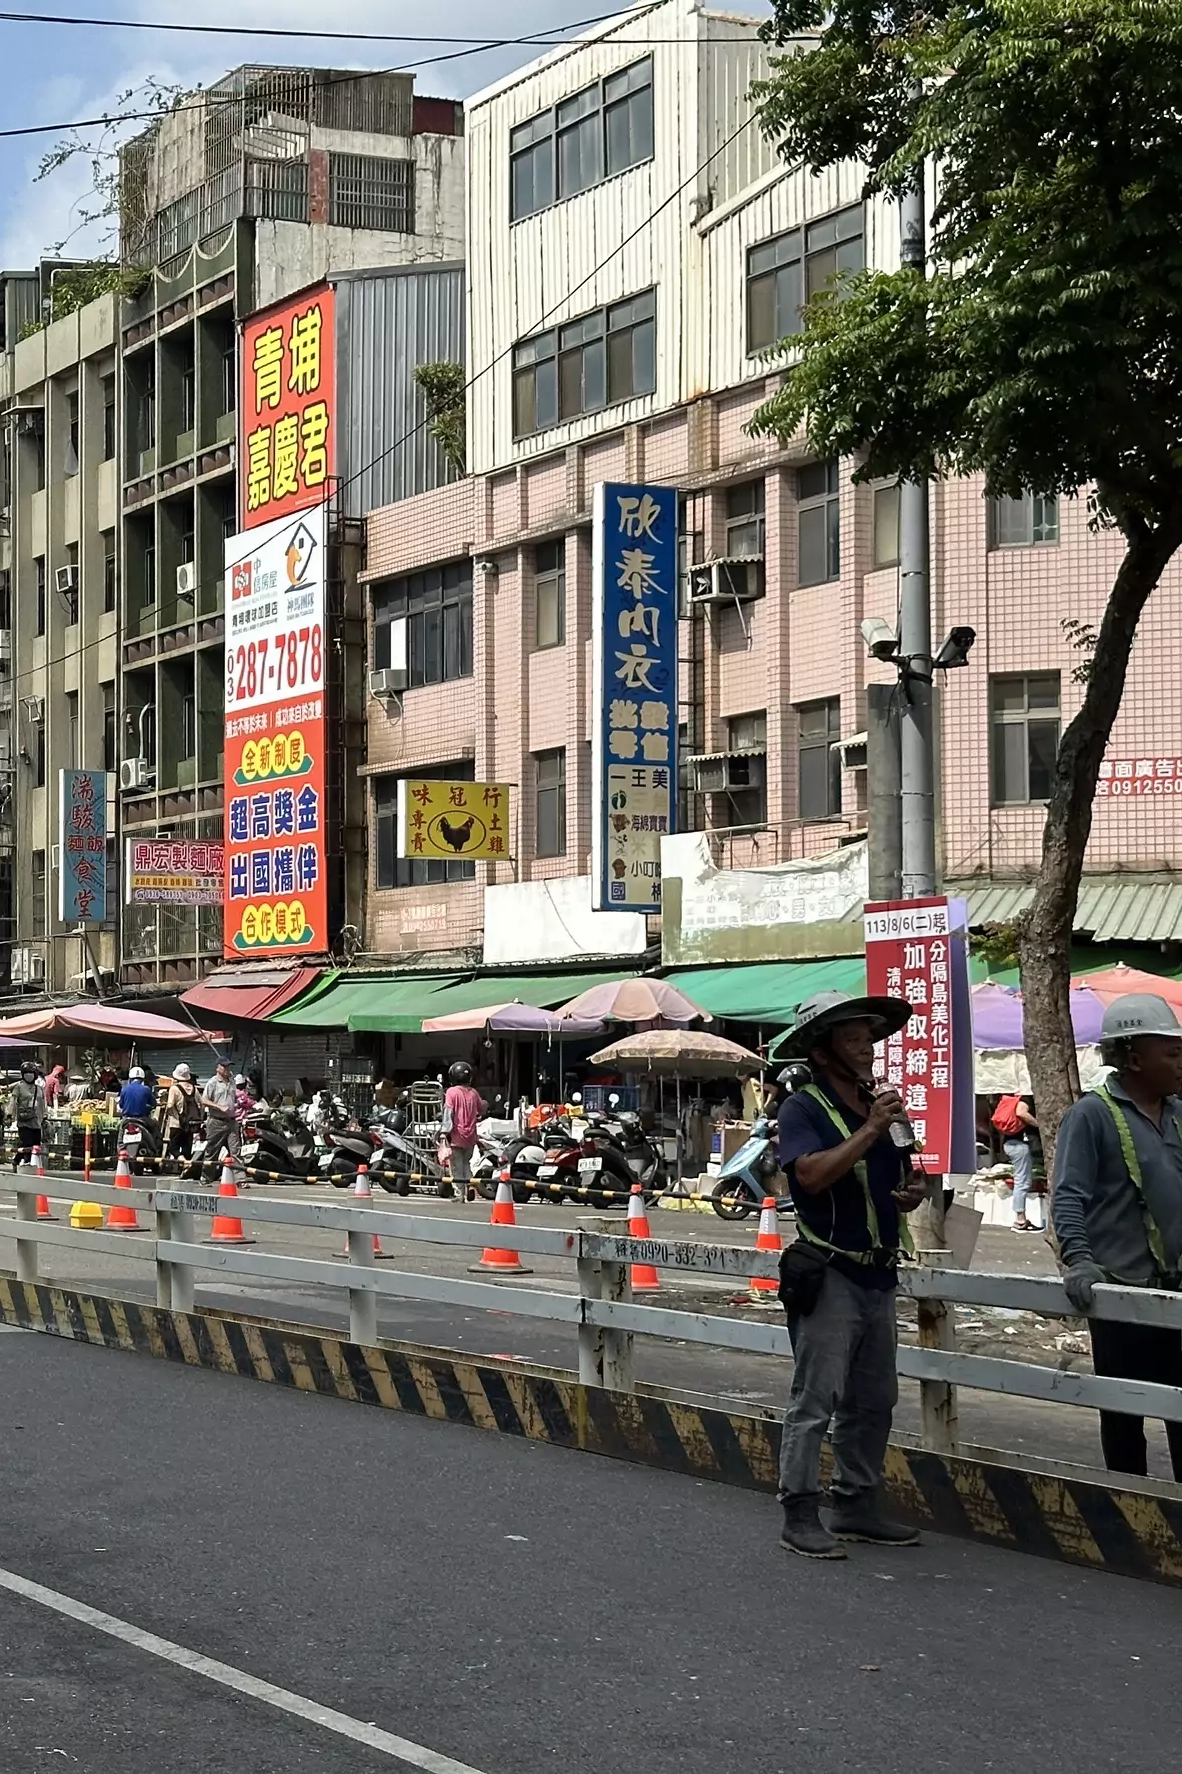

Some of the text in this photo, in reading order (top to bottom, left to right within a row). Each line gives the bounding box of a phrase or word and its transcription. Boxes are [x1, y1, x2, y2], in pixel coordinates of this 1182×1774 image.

[253, 304, 321, 415] 青埔
[247, 400, 329, 512] 嘉慶君
[236, 623, 322, 700] 287-7878
[245, 739, 301, 773] 全新制度
[229, 785, 318, 843] 超高獎金
[411, 784, 502, 809] 味冠行
[409, 809, 427, 853] 專賣
[487, 813, 505, 854] 土雞
[631, 814, 667, 833] 海綿寶寶
[135, 844, 224, 872] 鼎宏製麵廠
[229, 844, 318, 899] 出國攜伴
[73, 857, 97, 918] 食堂
[612, 882, 626, 900] 國
[245, 907, 302, 938] 合作模式
[930, 939, 949, 1088] 分隔島美化工程
